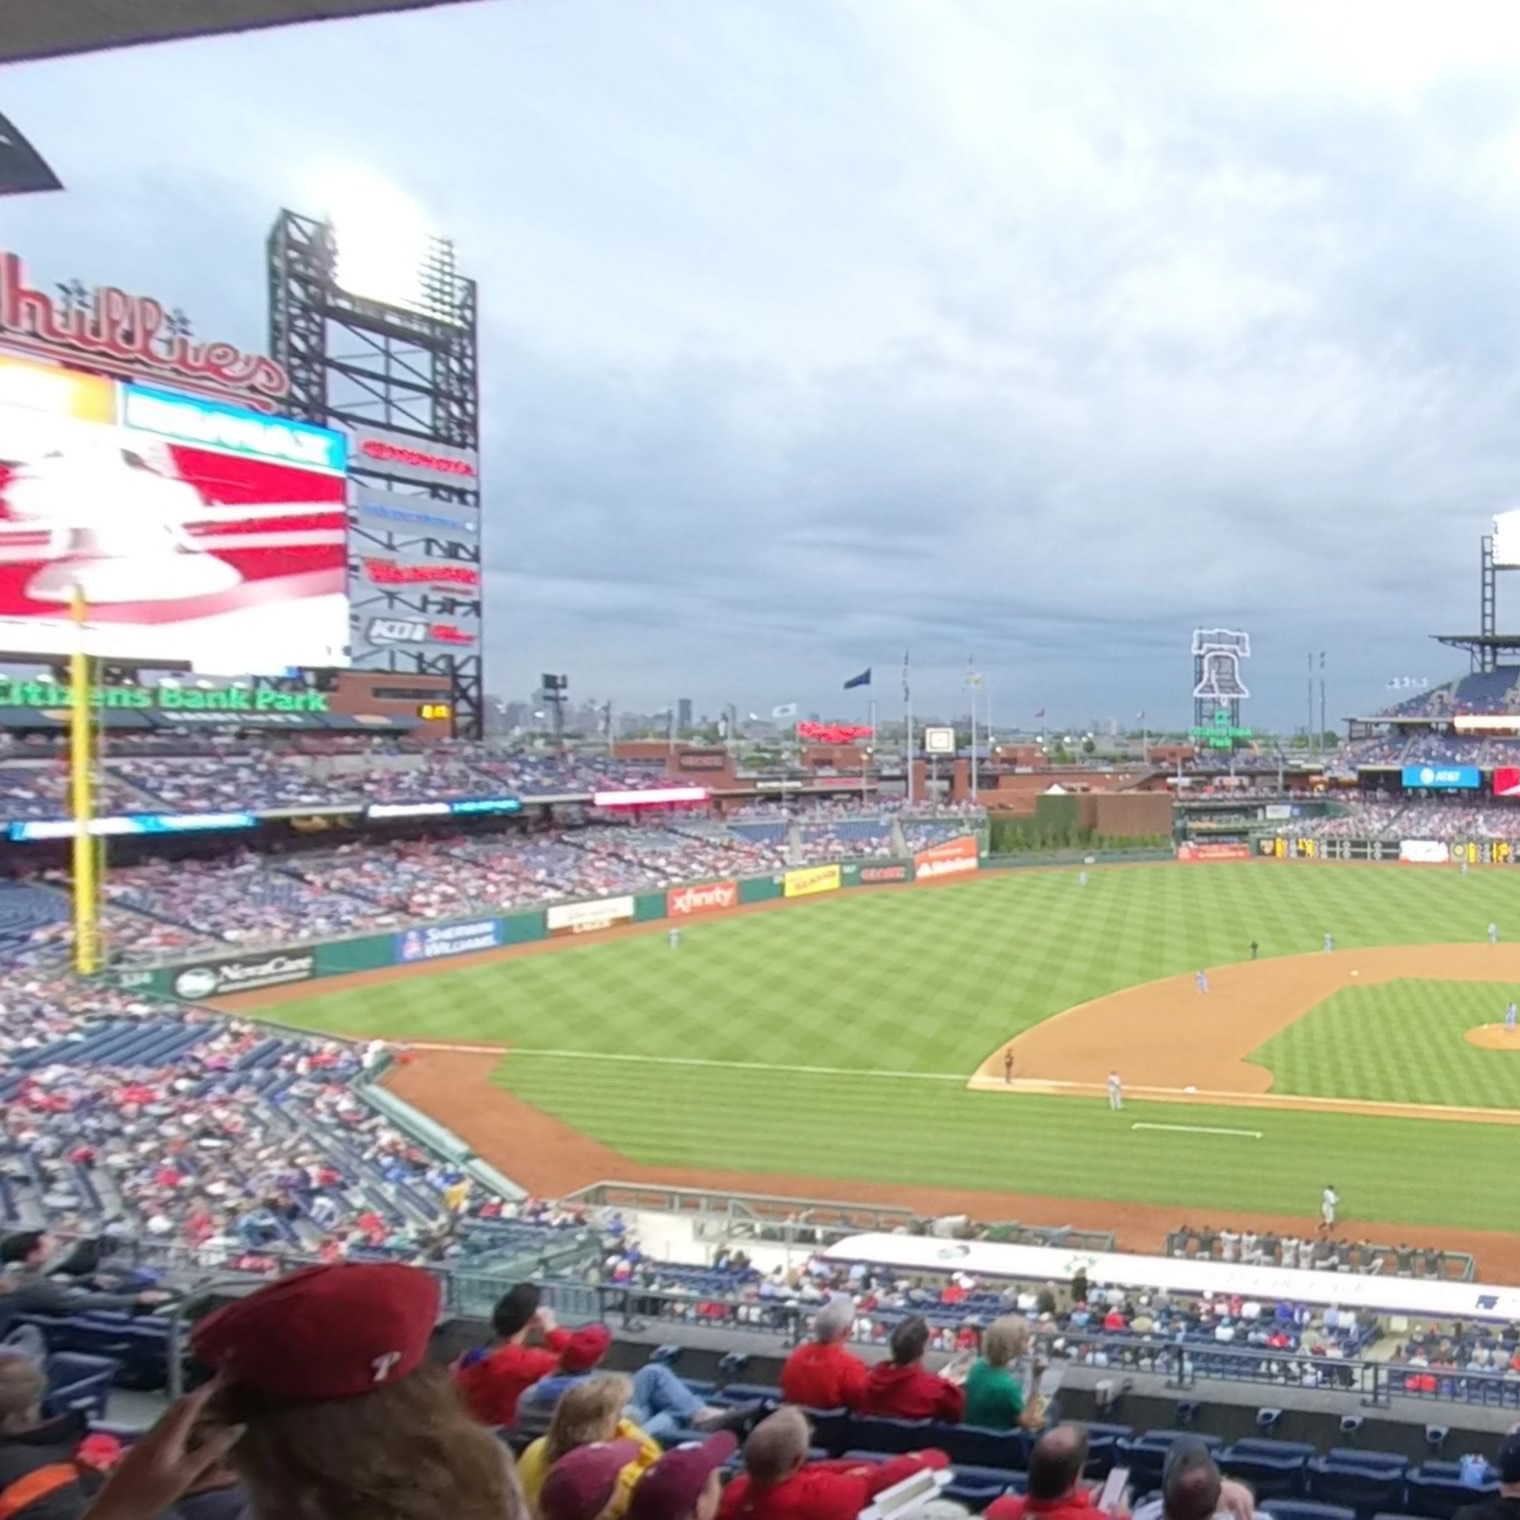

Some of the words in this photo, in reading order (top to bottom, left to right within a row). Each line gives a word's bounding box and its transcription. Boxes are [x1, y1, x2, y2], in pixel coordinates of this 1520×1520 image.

[0, 251, 290, 398] hillies
[159, 684, 250, 709] Bank
[256, 688, 329, 712] Park
[1435, 766, 1462, 782] AT&T
[672, 884, 735, 914] xfinity
[217, 956, 313, 982] NovaCare
